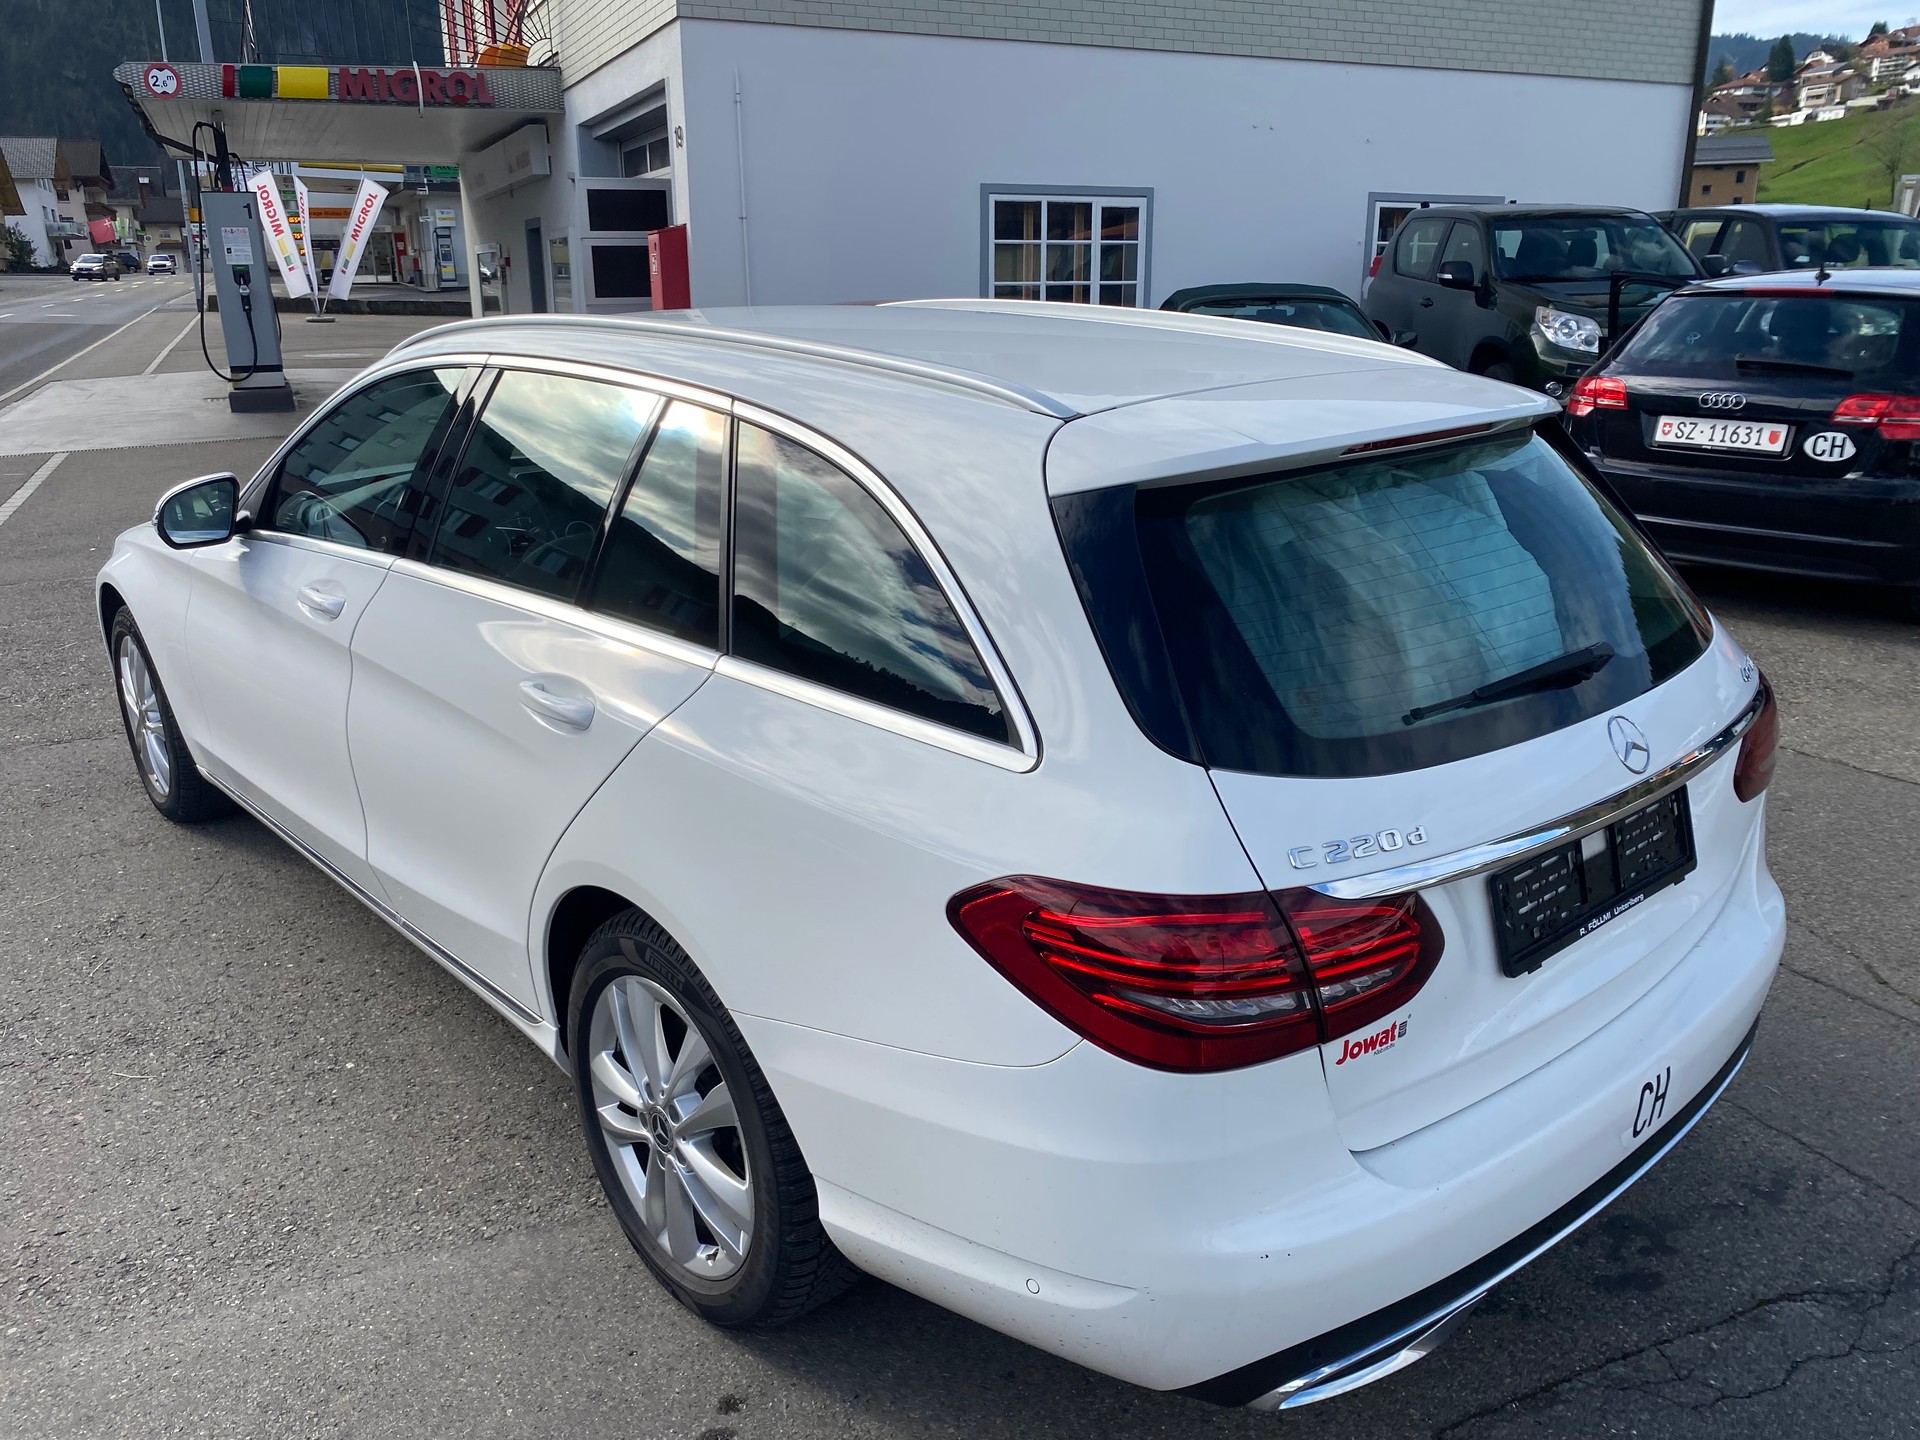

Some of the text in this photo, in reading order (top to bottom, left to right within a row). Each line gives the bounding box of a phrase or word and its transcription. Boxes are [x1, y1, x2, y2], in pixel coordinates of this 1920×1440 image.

[339, 67, 493, 104] MIGROL
[243, 203, 252, 219] 1
[351, 193, 378, 241] MIGROL
[1812, 435, 1847, 458] CH
[1580, 927, 1588, 936] R.
[1336, 1020, 1397, 1066] Jowat
[1633, 1066, 1671, 1138] CH
